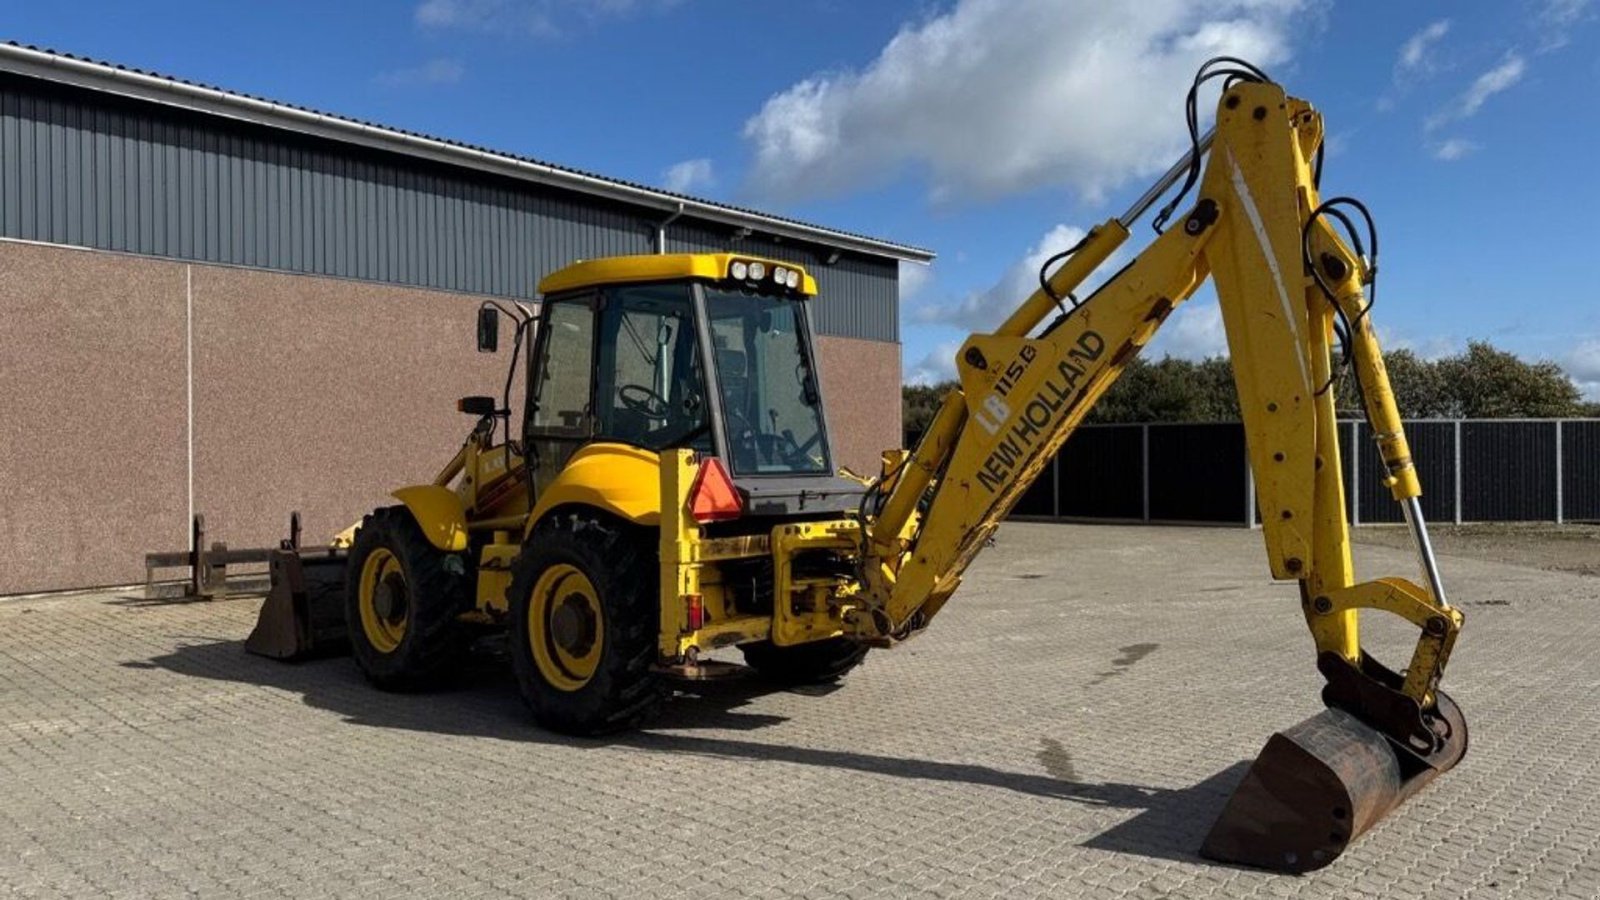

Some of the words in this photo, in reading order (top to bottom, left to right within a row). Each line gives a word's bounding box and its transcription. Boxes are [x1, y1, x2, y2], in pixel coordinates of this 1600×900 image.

[975, 394, 1011, 436] LB
[976, 433, 1023, 493] NEW
[1012, 330, 1105, 446] HOLLAND
